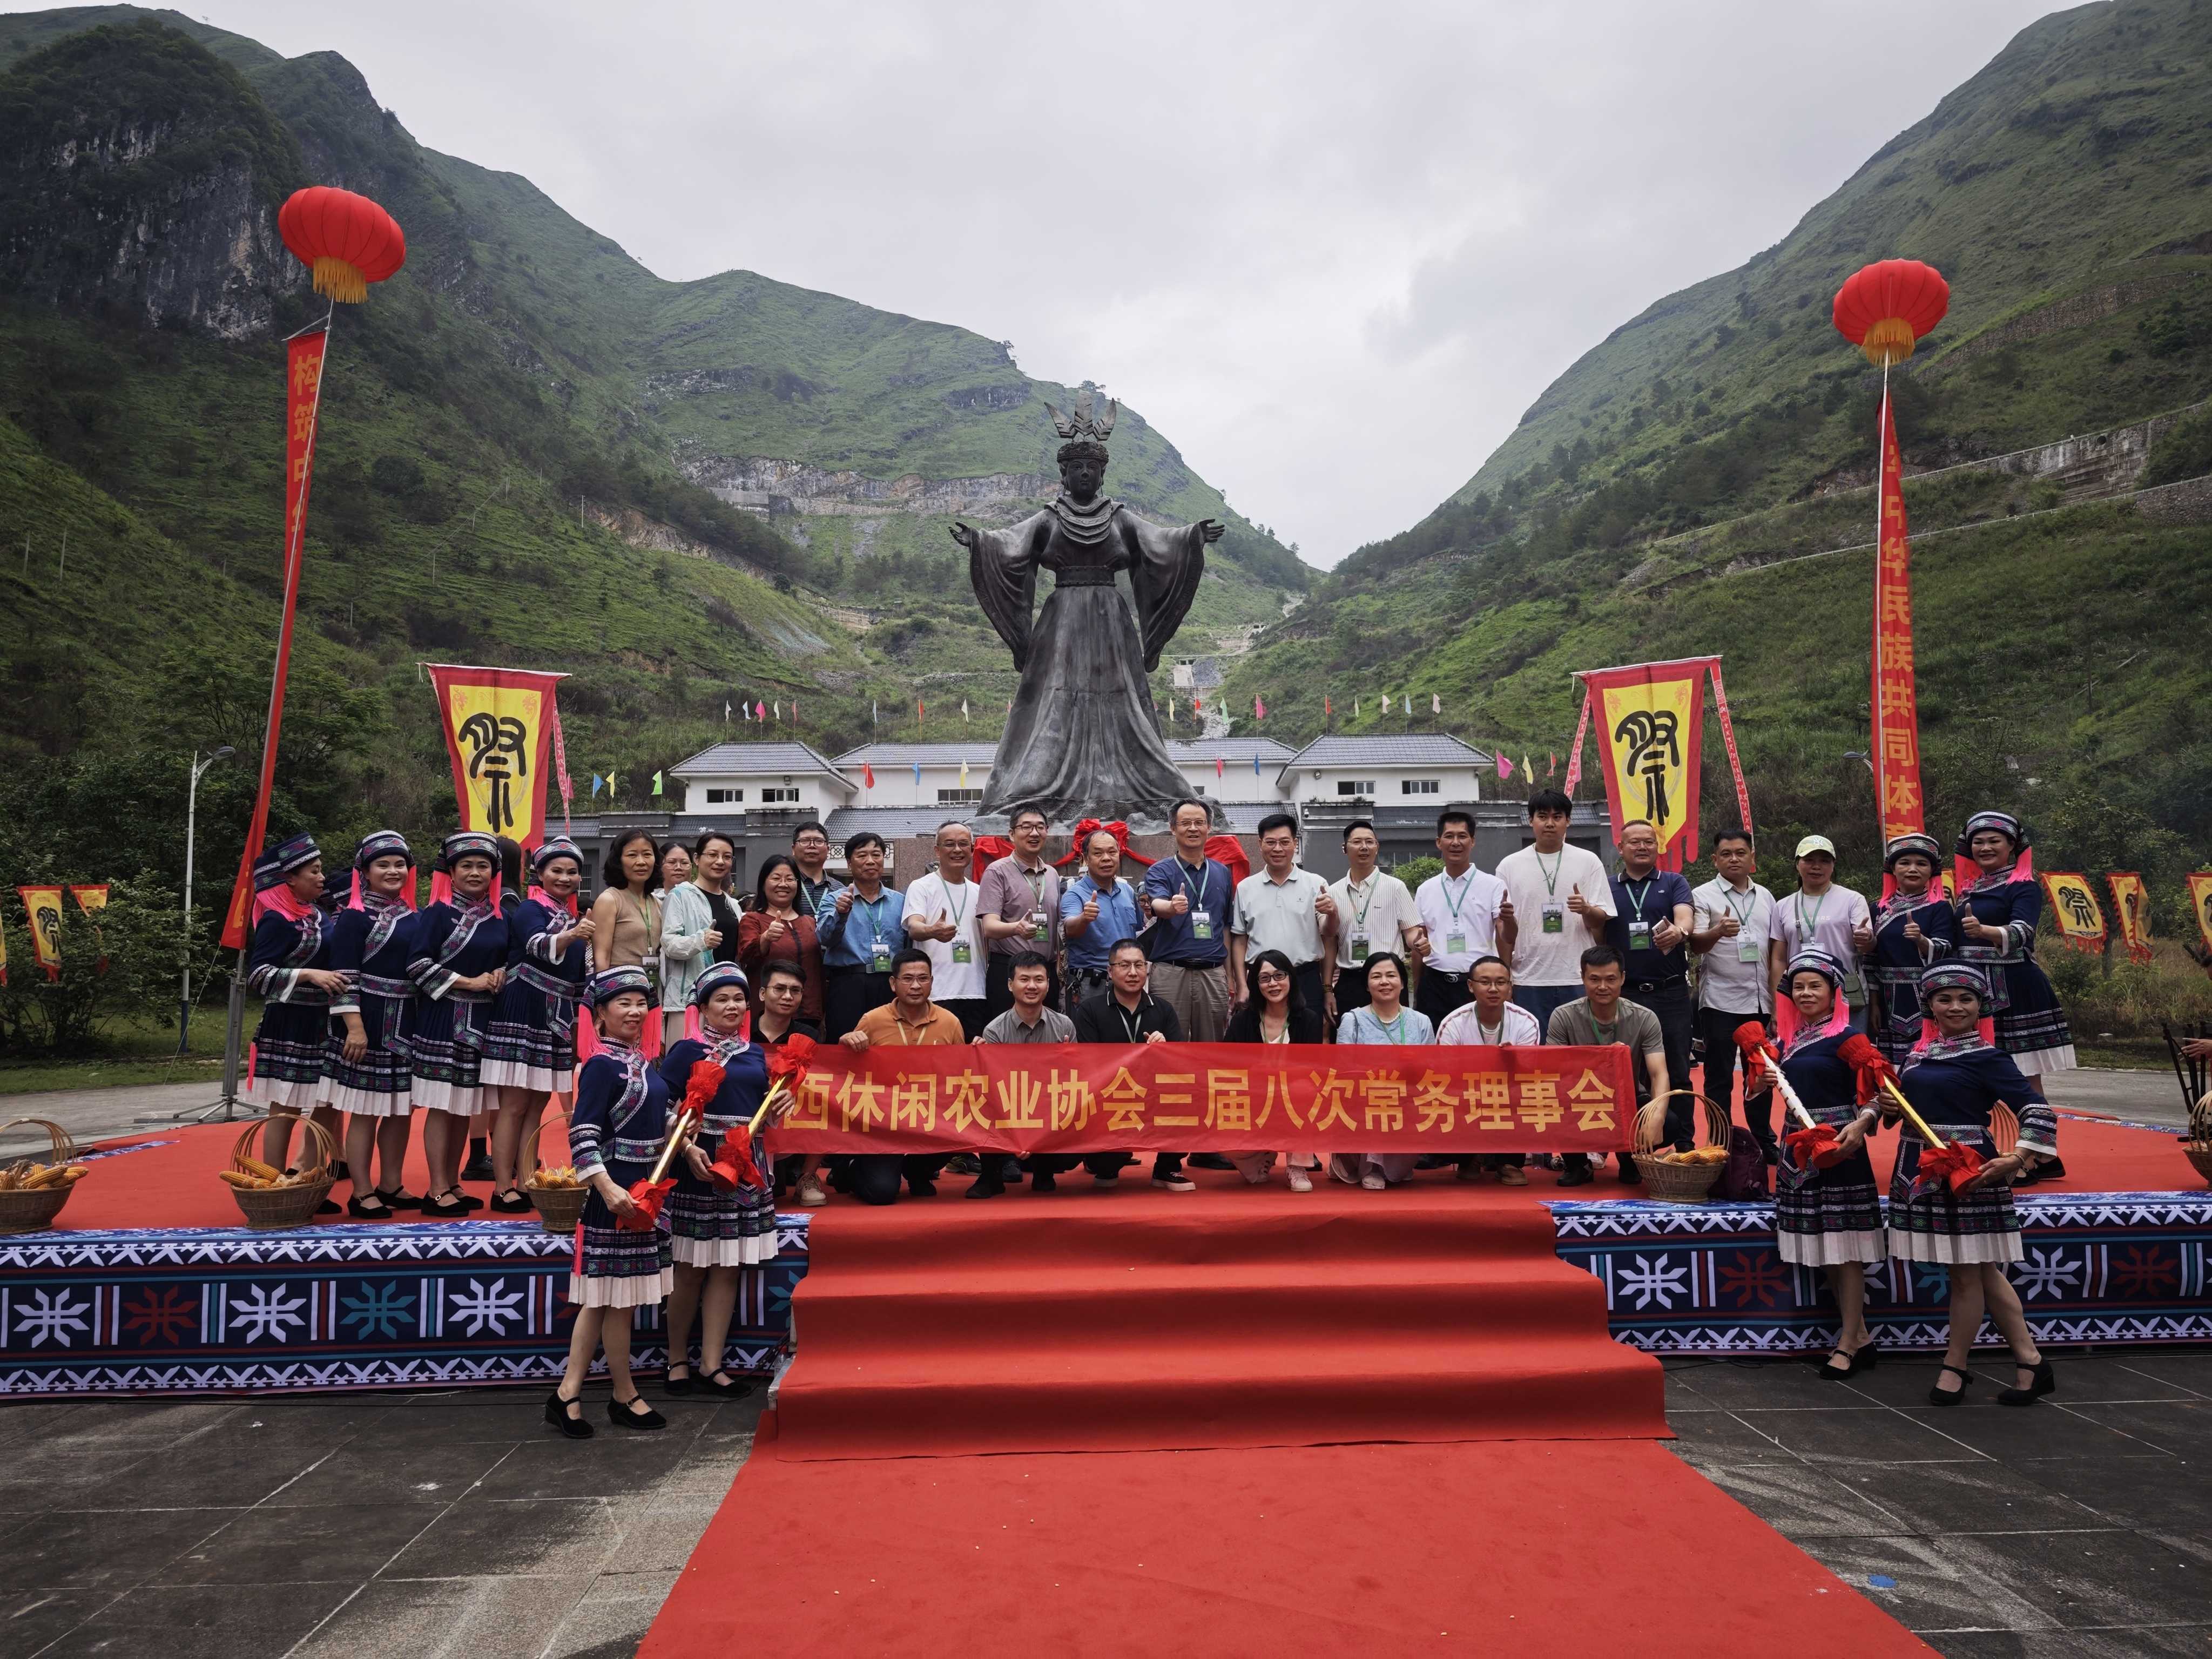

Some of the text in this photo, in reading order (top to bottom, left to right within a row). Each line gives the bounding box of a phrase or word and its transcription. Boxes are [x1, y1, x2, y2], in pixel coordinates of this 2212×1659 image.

[1880, 445, 1919, 840] 中华民族共同体
[768, 1068, 1616, 1132] 西休闲农业协会三届八次常务理事会
